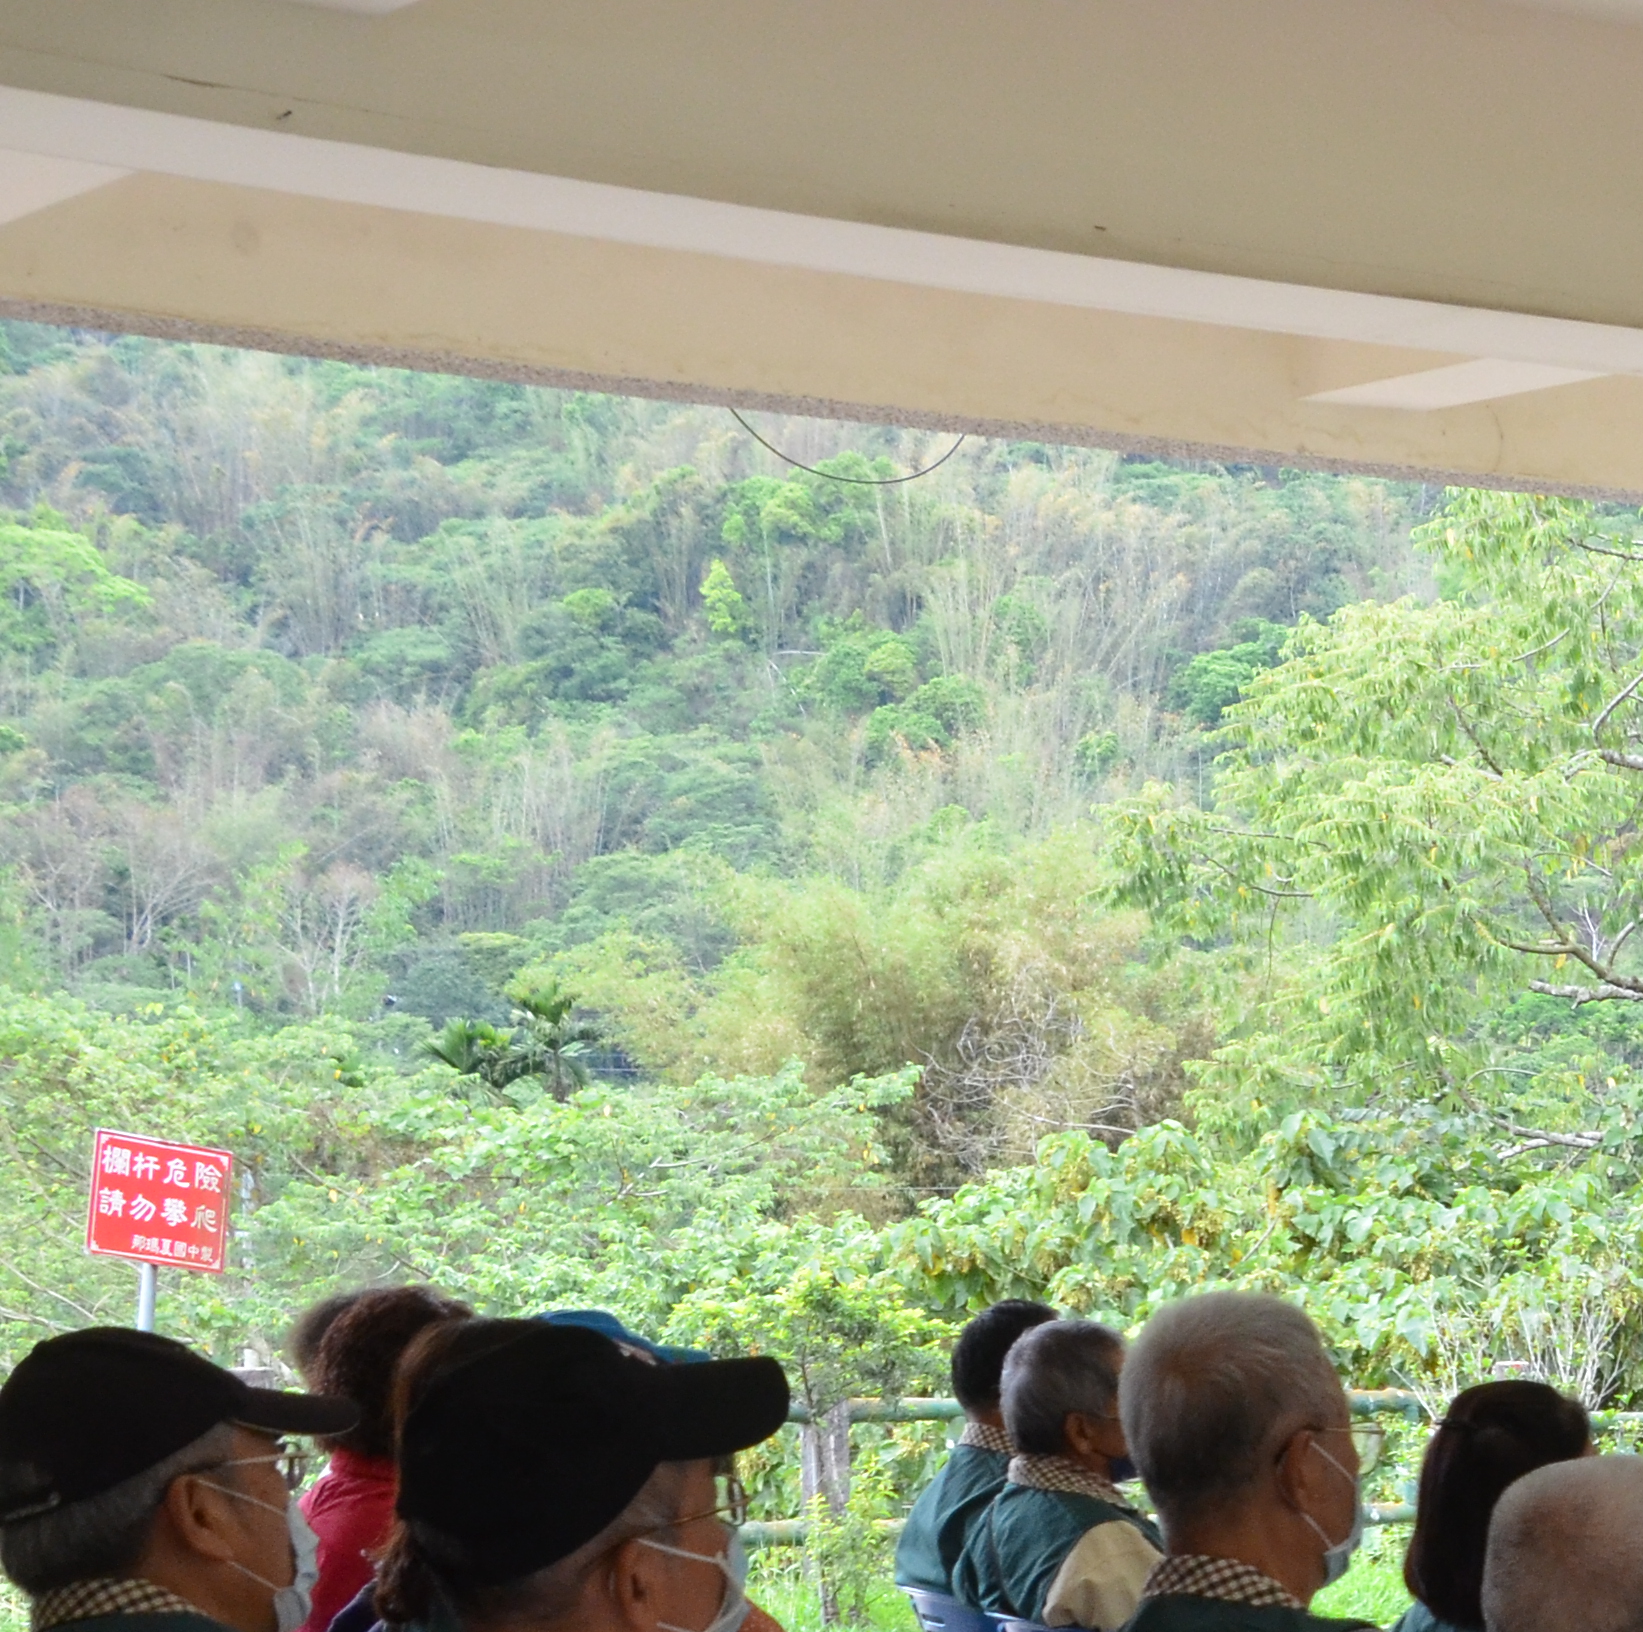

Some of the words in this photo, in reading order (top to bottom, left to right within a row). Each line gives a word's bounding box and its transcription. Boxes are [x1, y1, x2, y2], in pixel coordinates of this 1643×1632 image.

[102, 1145, 223, 1194] 欄杆危險
[99, 1187, 219, 1233] 請勿攀爬
